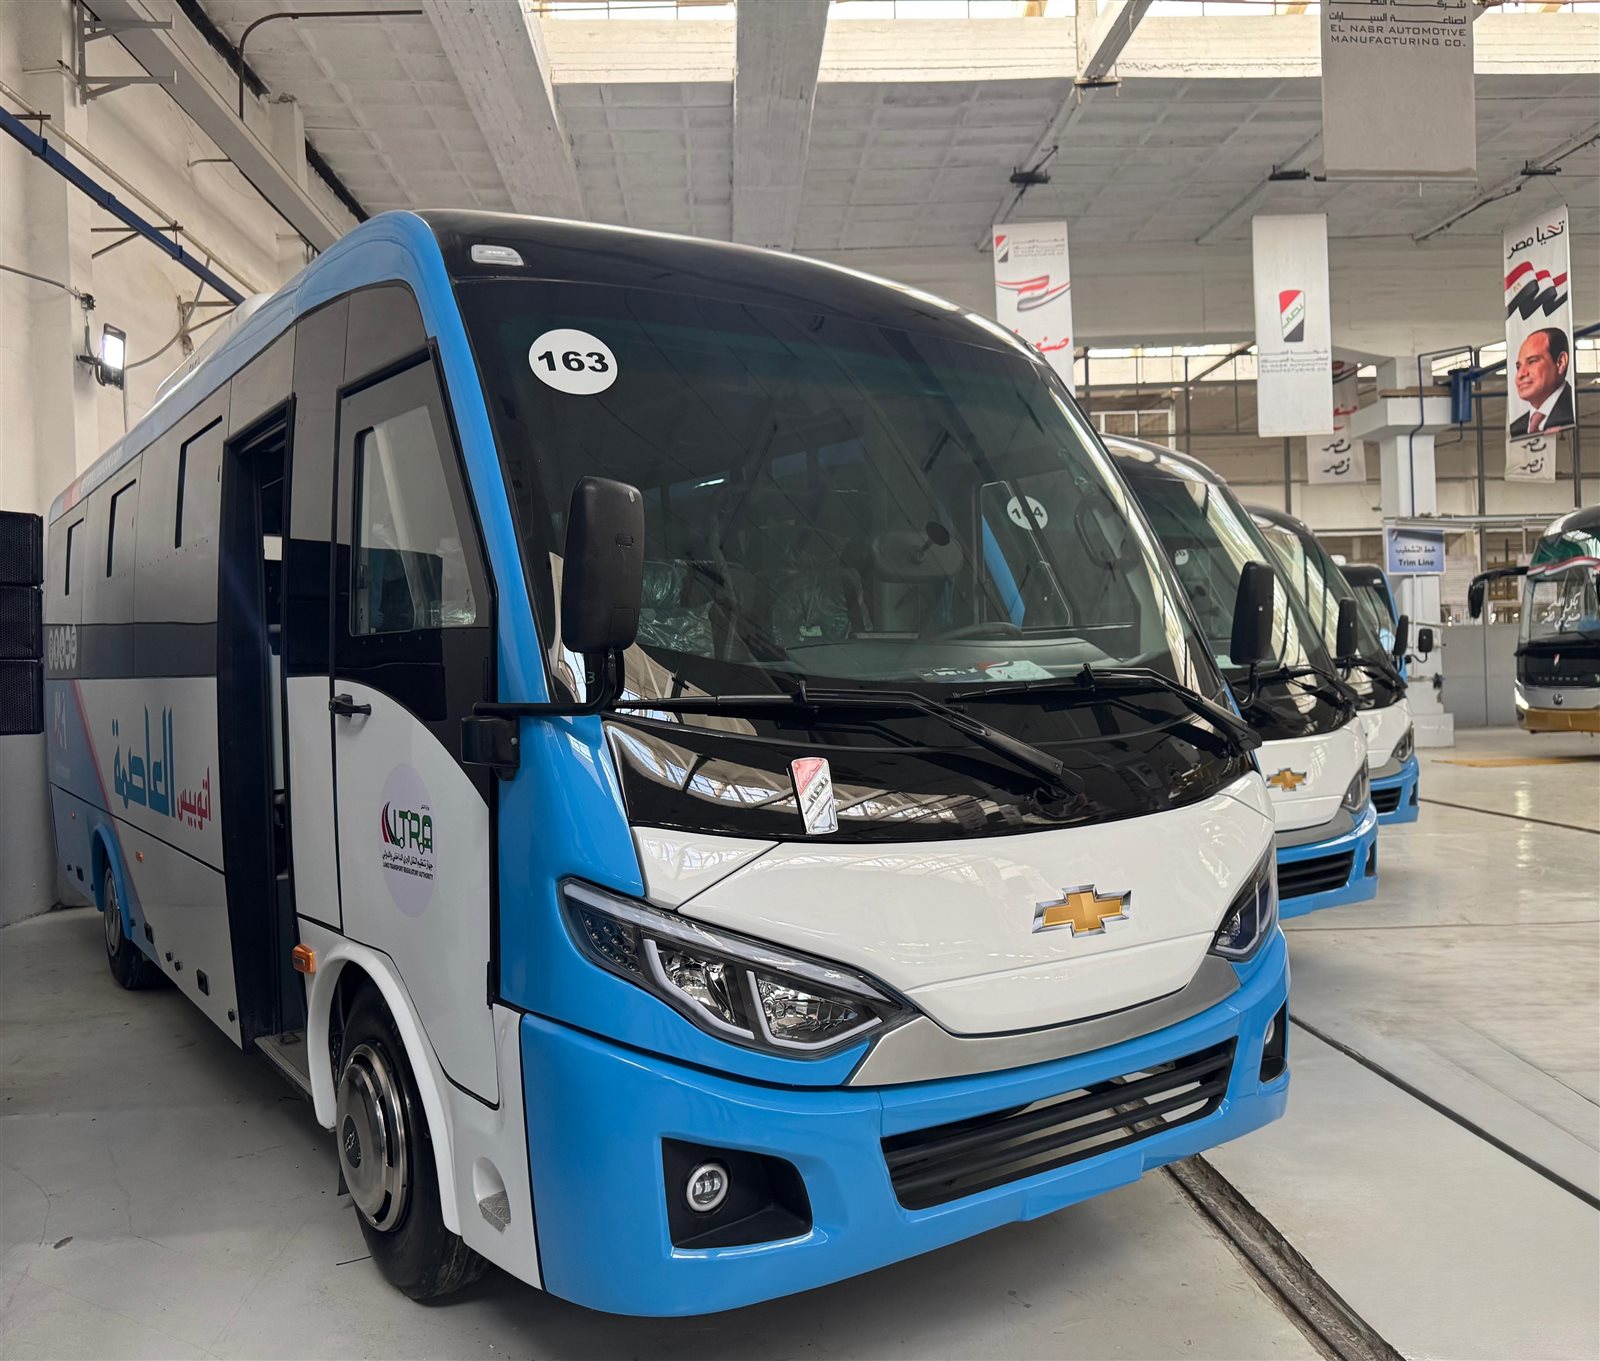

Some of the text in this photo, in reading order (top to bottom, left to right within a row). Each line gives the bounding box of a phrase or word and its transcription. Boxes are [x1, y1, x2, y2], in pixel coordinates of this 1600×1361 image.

[1330, 24, 1467, 37] EL NASR AUTOMOTIVE
[1330, 35, 1467, 47] MANUFACTURING CO.
[1507, 220, 1565, 260] تحيا مصر
[537, 350, 609, 373] 163
[1011, 506, 1044, 520] 14
[1398, 559, 1435, 567] Trim Line
[112, 703, 176, 818] العاصمة
[177, 766, 212, 830] اتوبيس
[390, 809, 433, 854] LTRA
